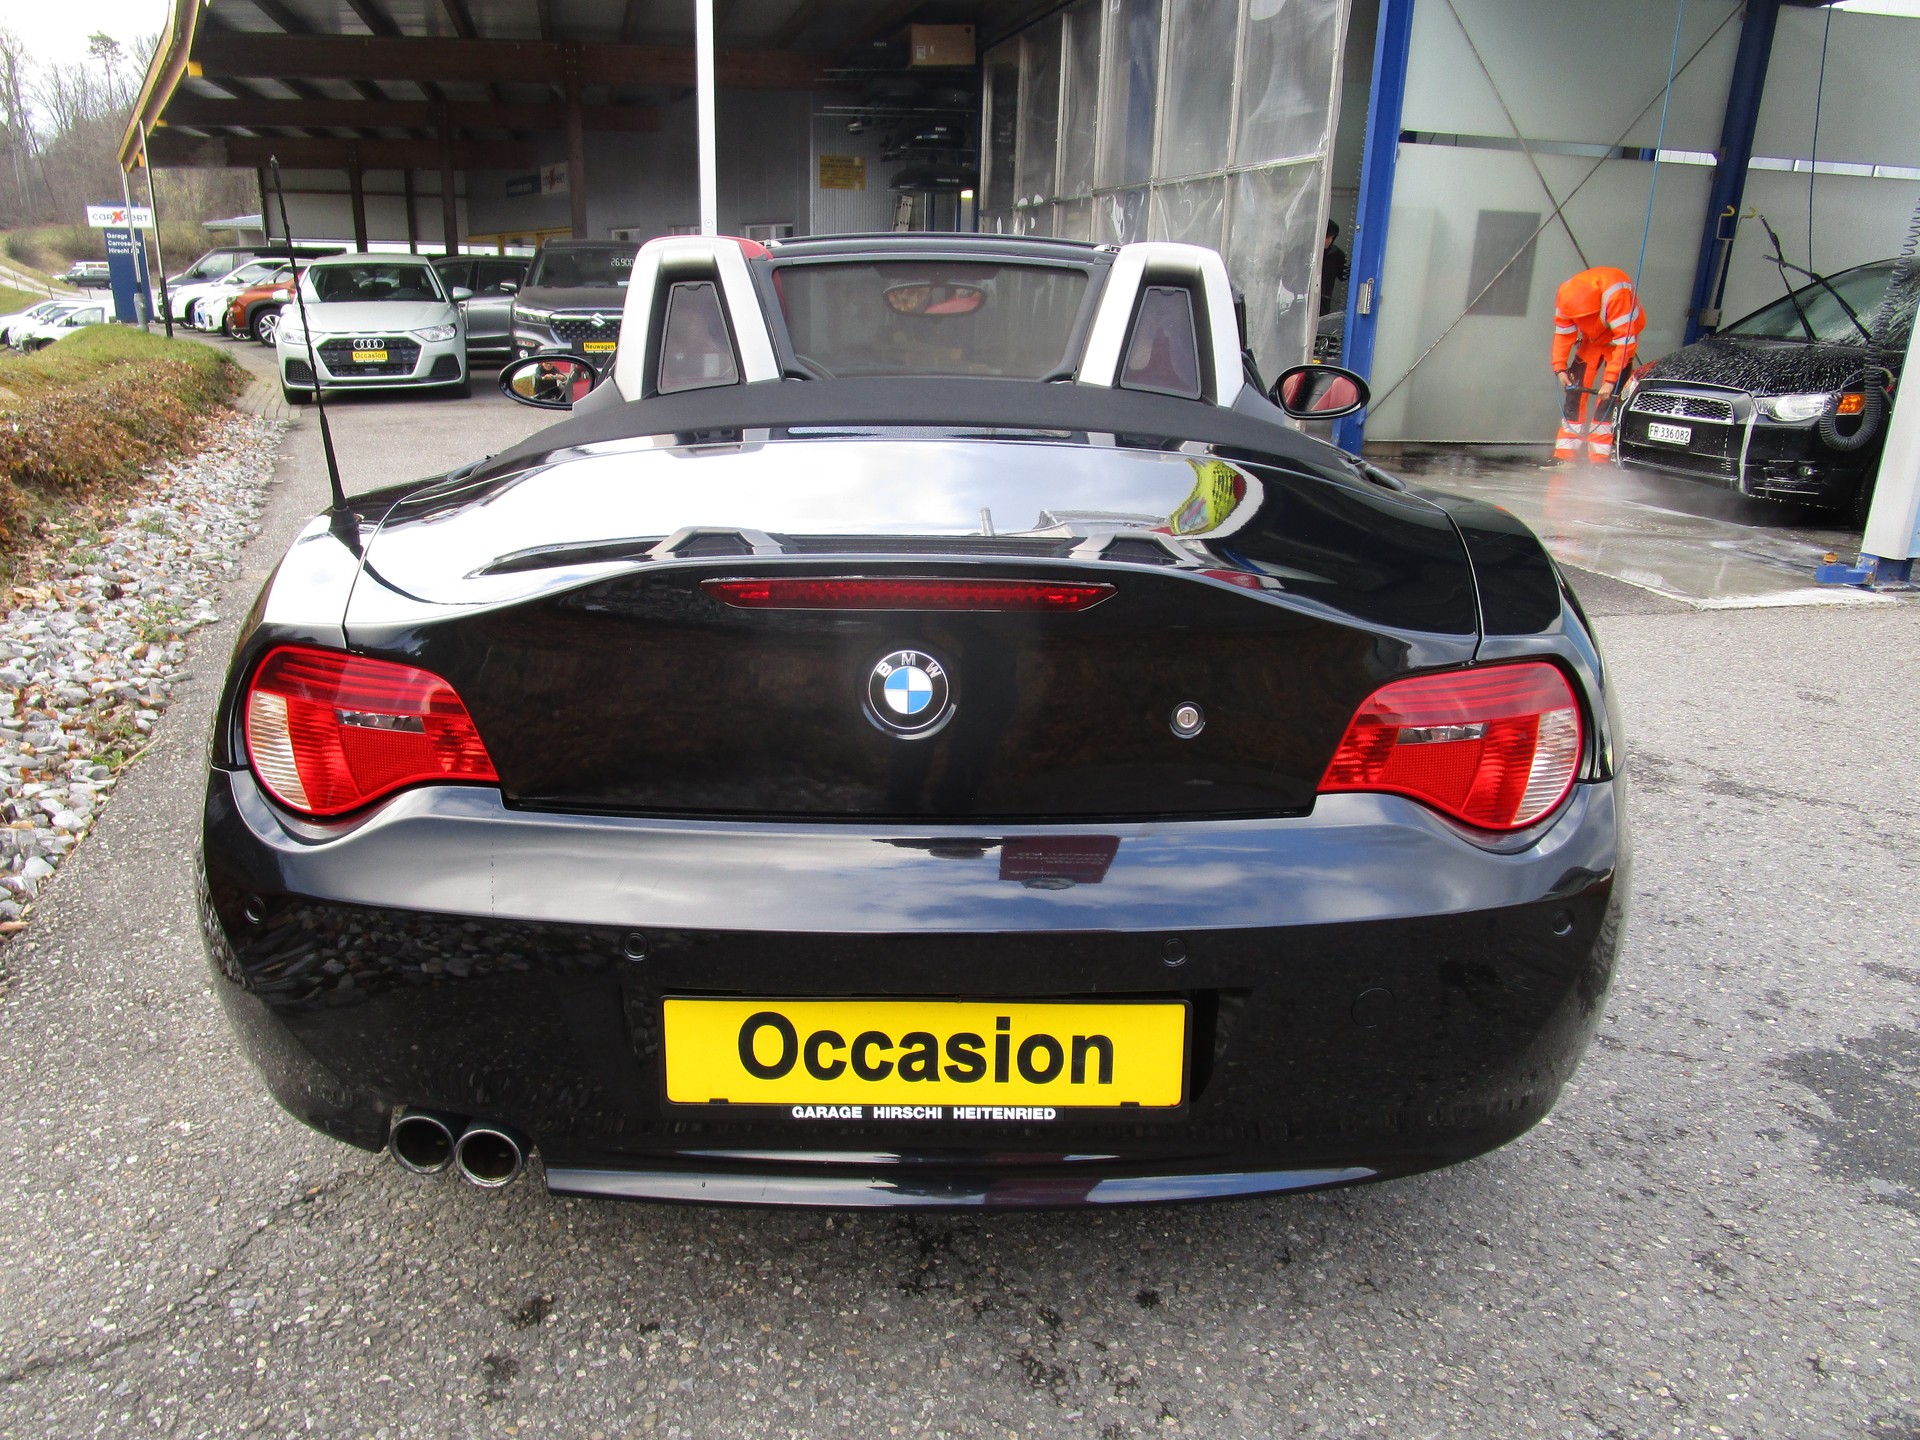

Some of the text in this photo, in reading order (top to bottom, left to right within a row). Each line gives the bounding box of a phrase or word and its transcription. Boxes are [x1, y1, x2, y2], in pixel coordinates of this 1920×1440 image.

[585, 343, 615, 351] Neuwagen
[876, 652, 942, 679] BMW
[738, 1011, 1113, 1084] Occasion
[792, 1106, 1057, 1120] GARAGE HIRSCHI HEITENRIED
